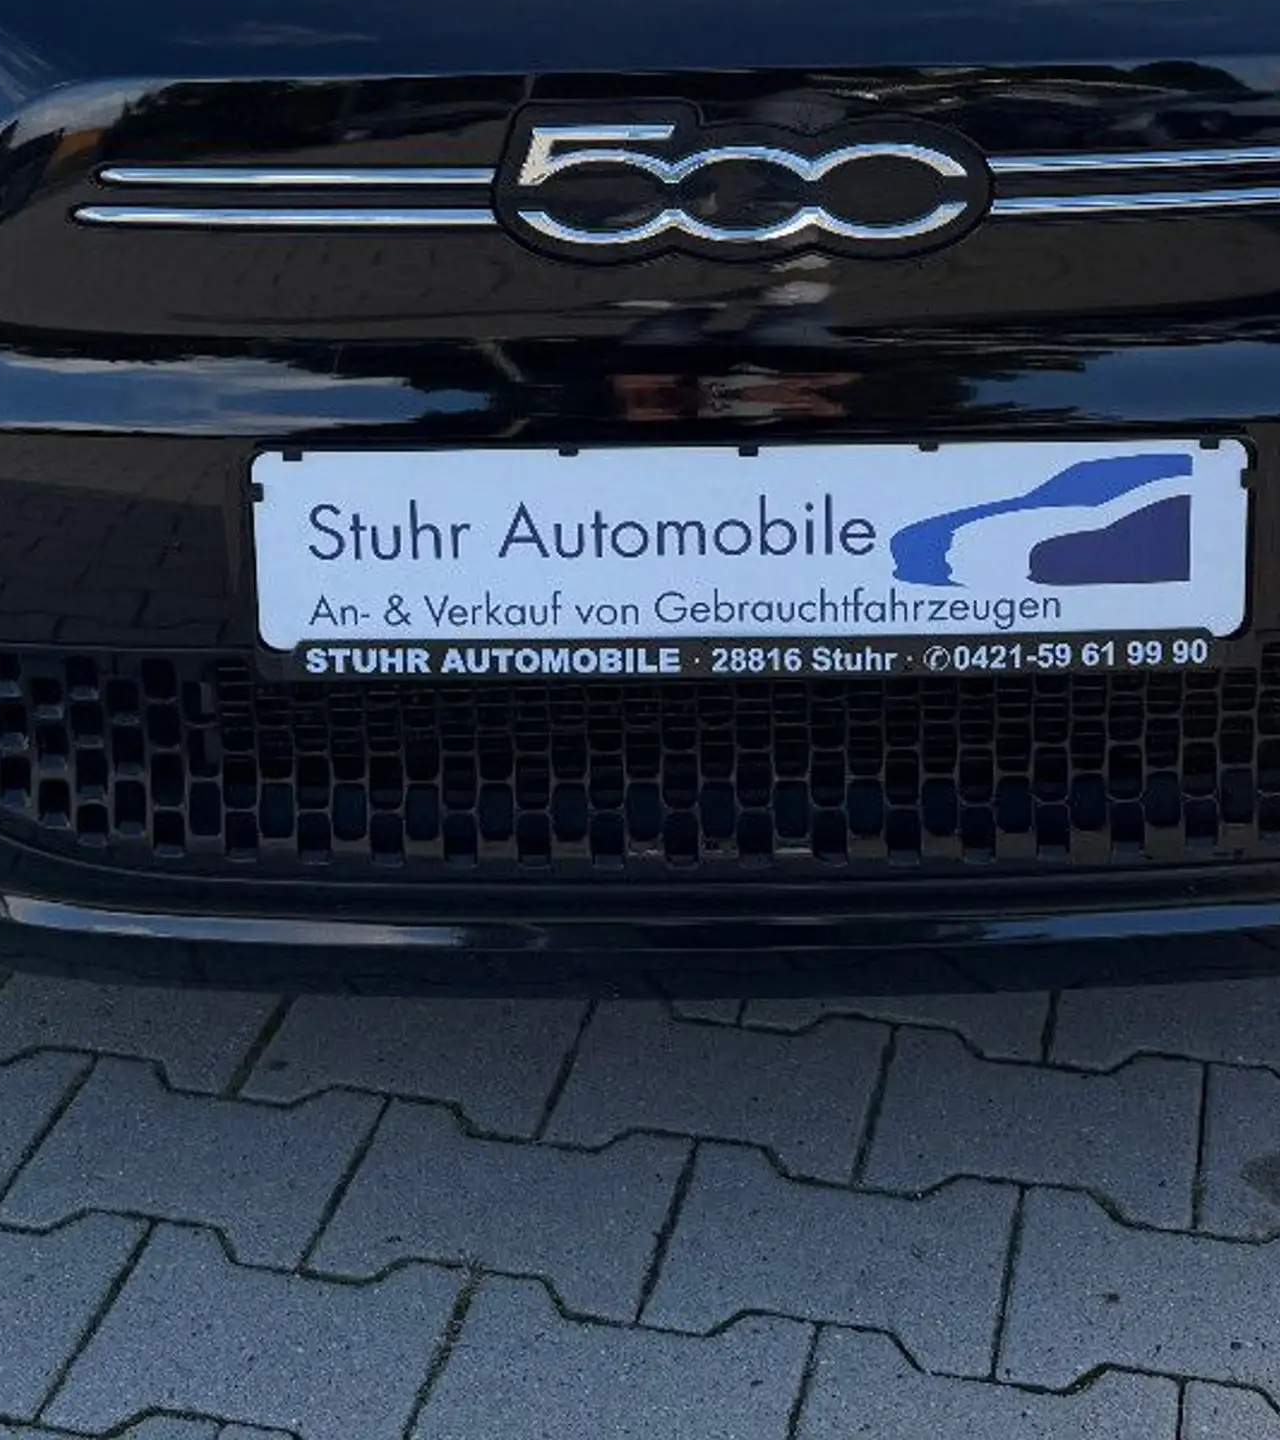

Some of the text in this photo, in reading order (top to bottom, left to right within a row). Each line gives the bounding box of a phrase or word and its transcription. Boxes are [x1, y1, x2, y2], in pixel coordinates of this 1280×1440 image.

[519, 124, 968, 244] 500
[308, 493, 877, 561] Stuhr Automobile
[308, 586, 1062, 629] An- & Verkauf von Gebrauchtfahrzeugen
[305, 648, 432, 675] STUHR
[440, 646, 682, 675] AUTOMOBILE
[711, 646, 803, 673] 28816
[811, 645, 898, 672] Stuhr
[1081, 640, 1118, 667] 61
[1126, 640, 1163, 666] 99
[1171, 638, 1209, 665] 90
